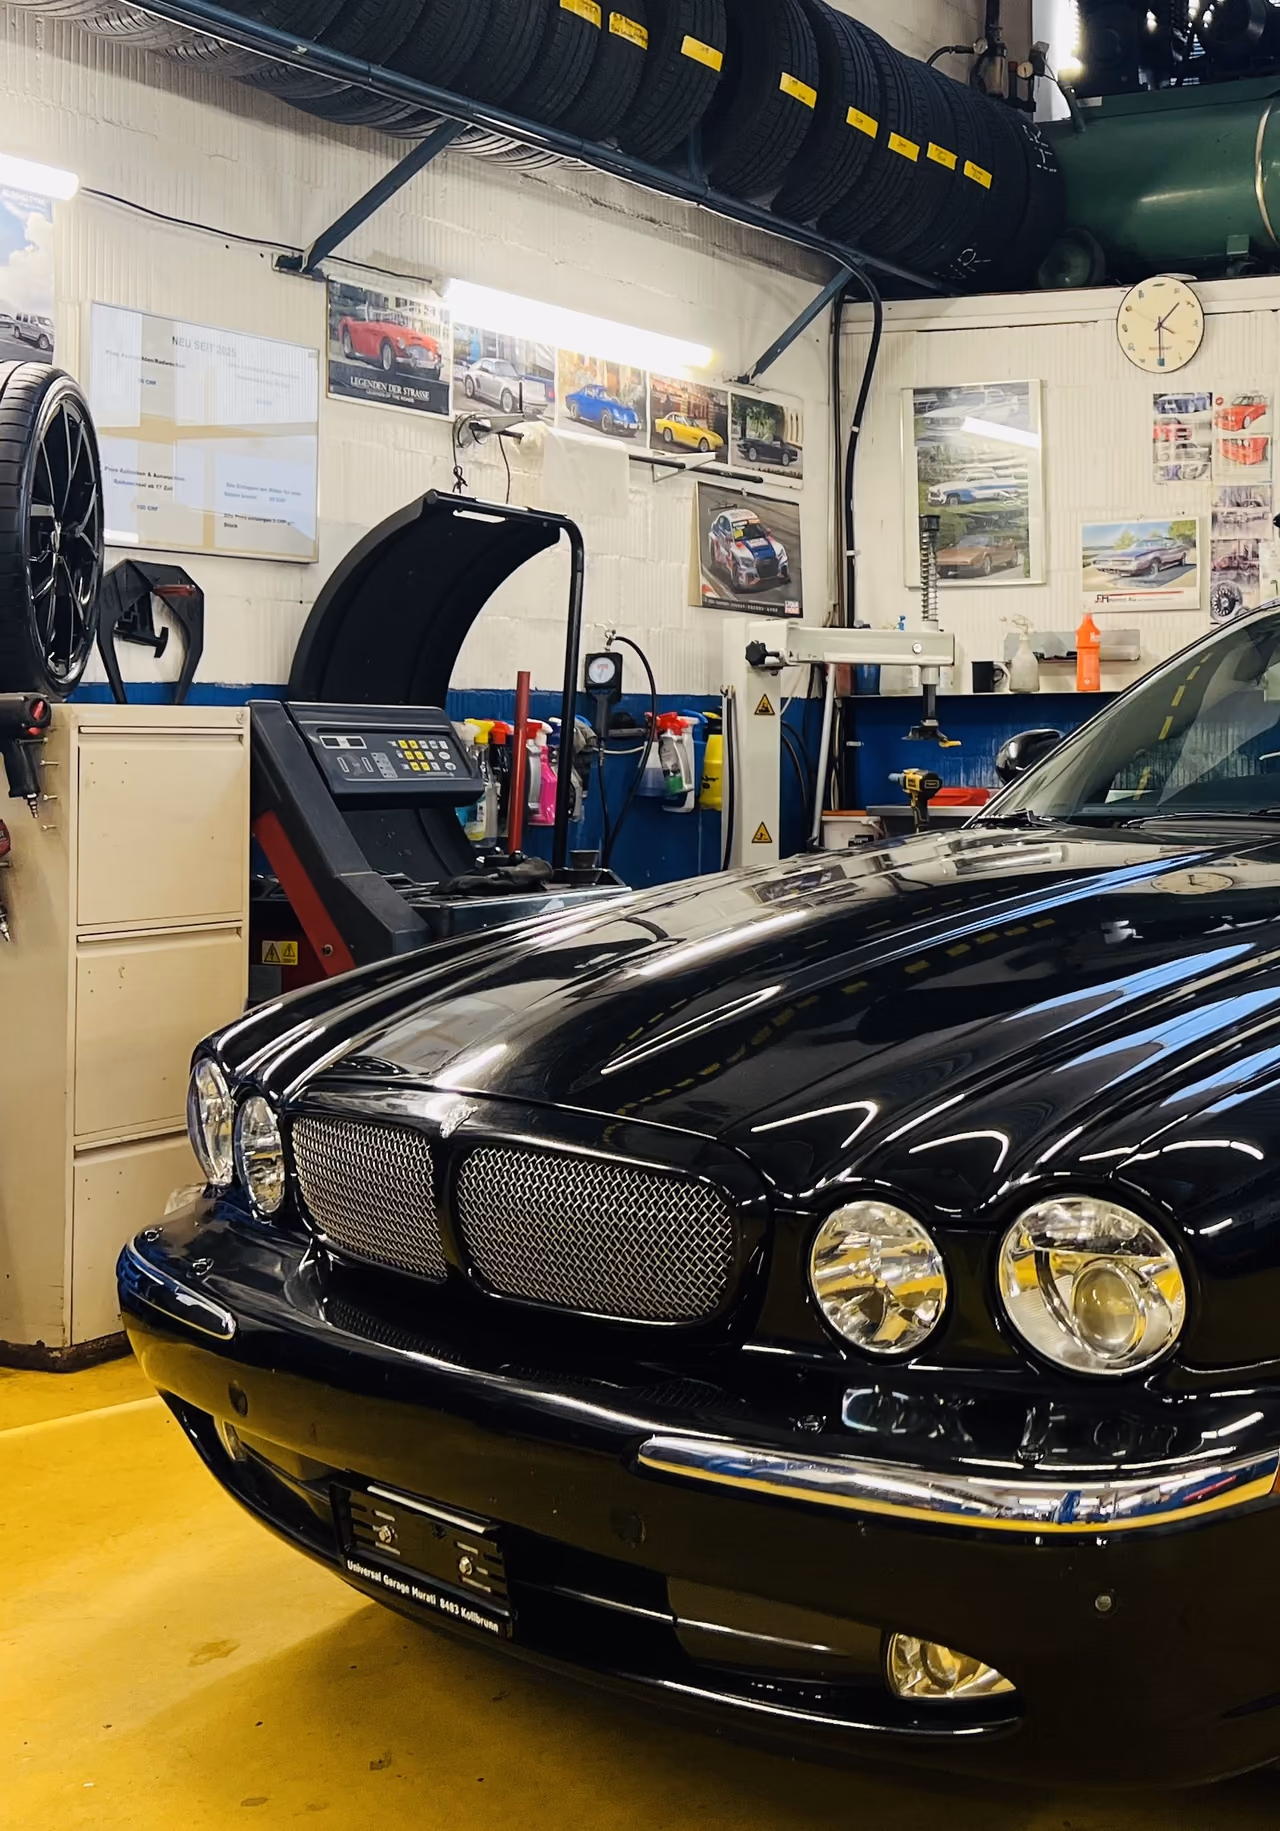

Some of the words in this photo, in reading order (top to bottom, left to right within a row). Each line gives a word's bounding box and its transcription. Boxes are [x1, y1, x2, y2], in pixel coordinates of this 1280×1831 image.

[171, 336, 193, 349] NEU
[350, 375, 387, 391] LEGENDEN
[388, 383, 402, 394] DER
[403, 386, 430, 401] STRASSE
[347, 1559, 382, 1582] Universal
[383, 1574, 410, 1594] Garage
[411, 1586, 436, 1605] Murati
[439, 1598, 459, 1615] 8483
[460, 1607, 499, 1633] Kollbrunn
